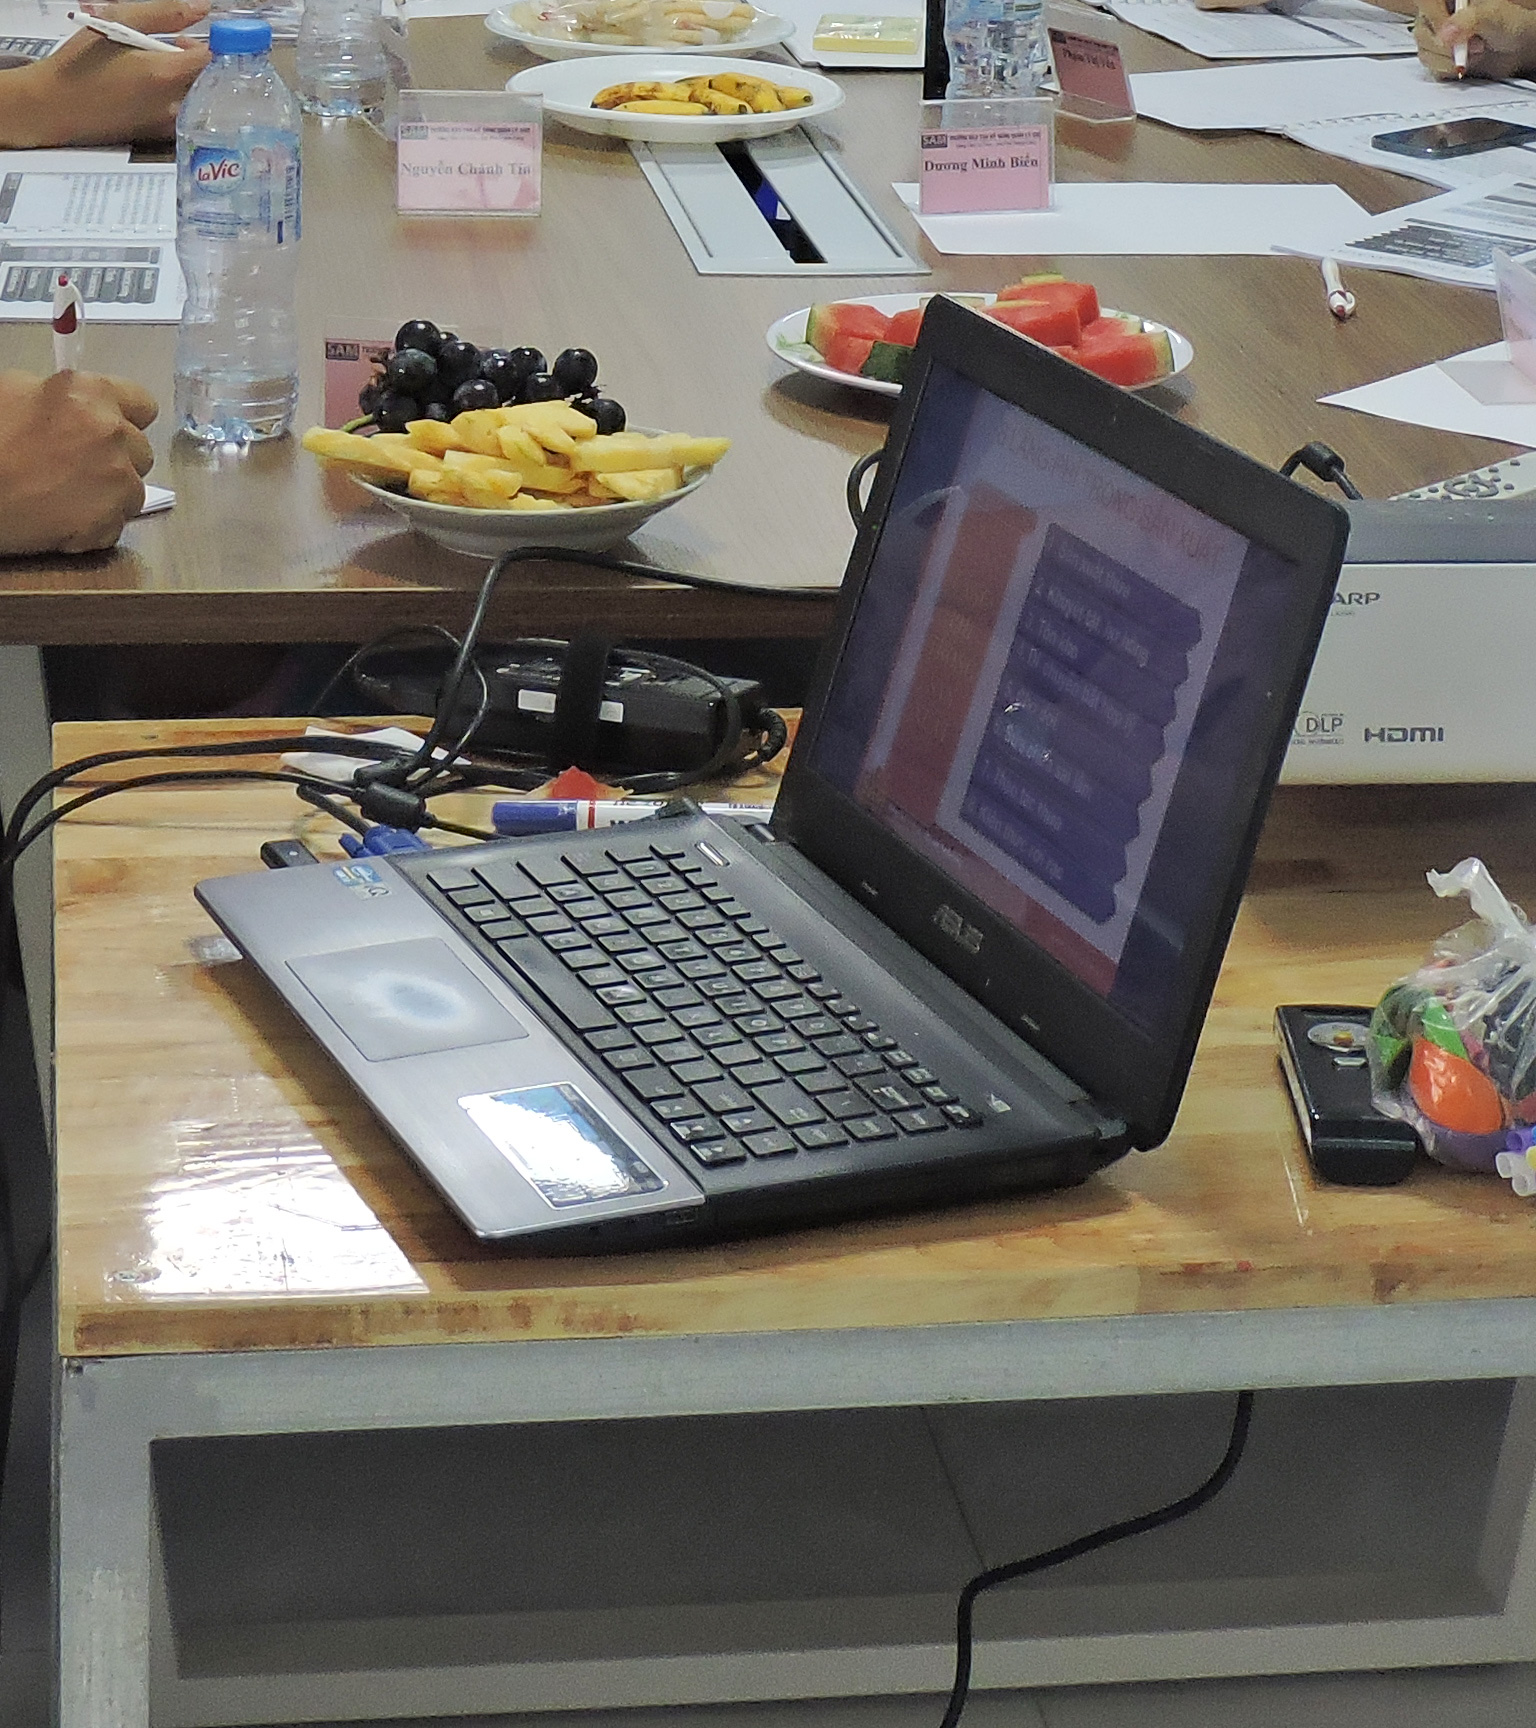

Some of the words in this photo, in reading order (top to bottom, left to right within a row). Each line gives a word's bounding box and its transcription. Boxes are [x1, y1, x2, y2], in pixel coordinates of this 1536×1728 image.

[971, 157, 1006, 170] Minh
[1332, 591, 1381, 606] ARP
[1305, 716, 1344, 734] DLP
[1364, 726, 1445, 743] HDMI
